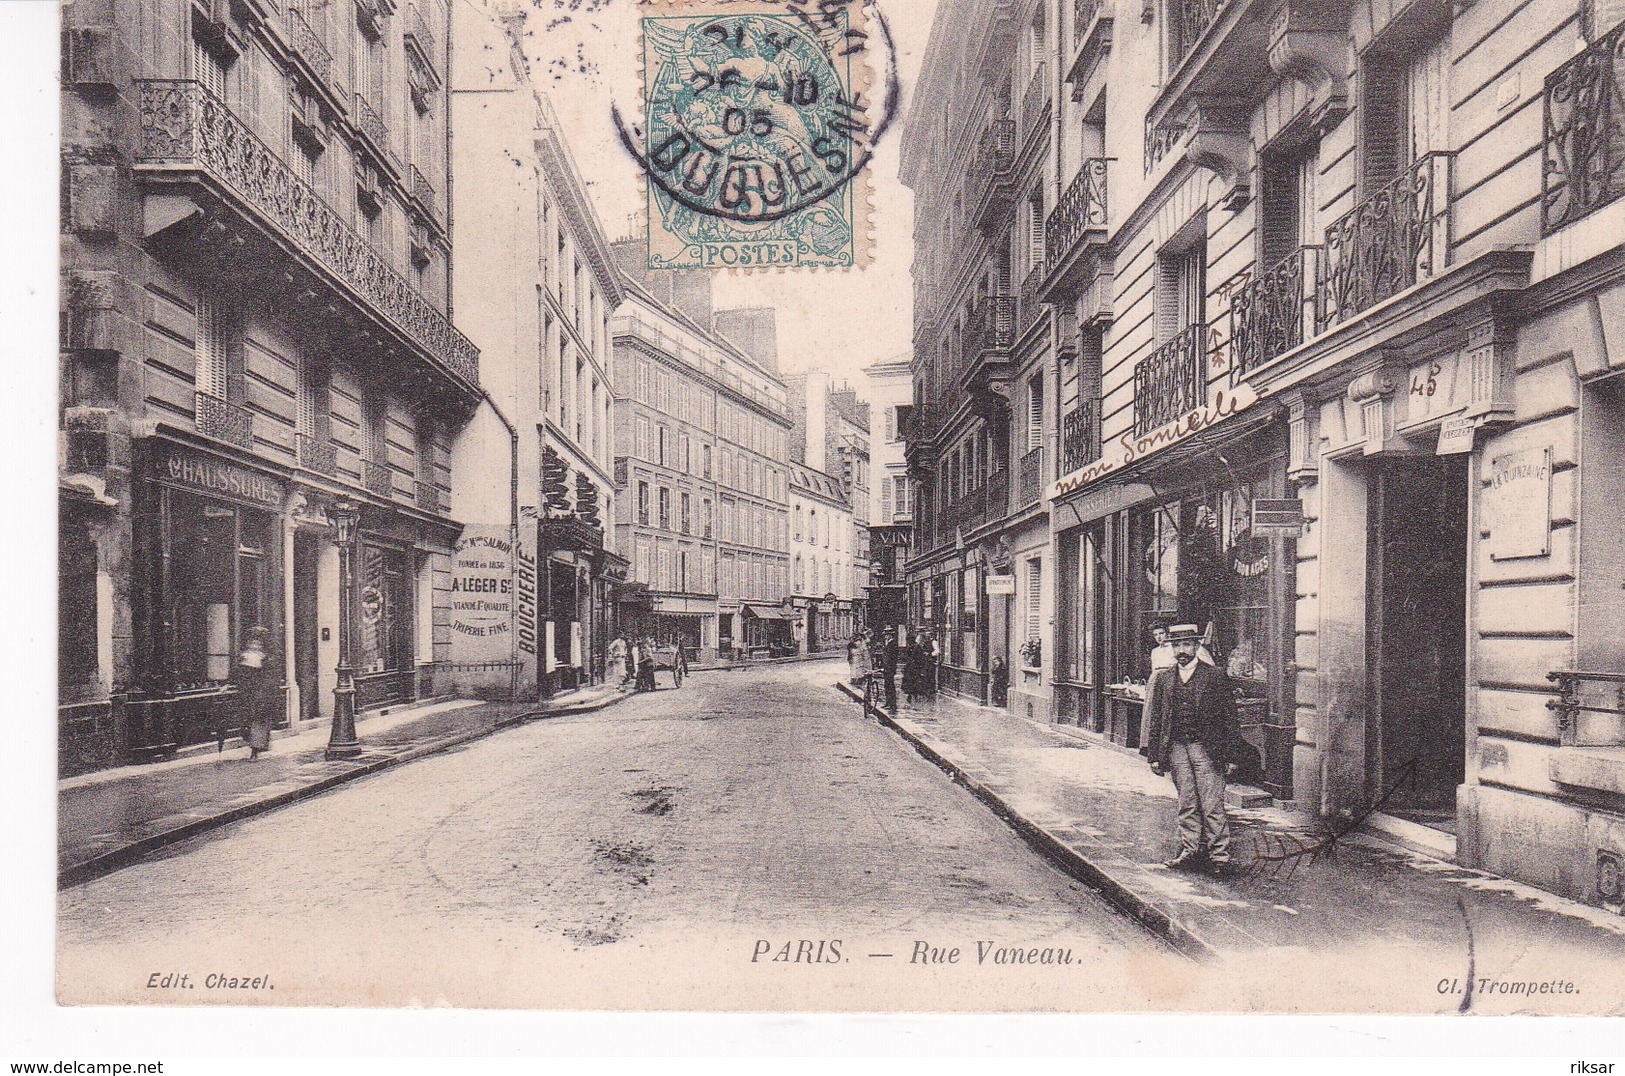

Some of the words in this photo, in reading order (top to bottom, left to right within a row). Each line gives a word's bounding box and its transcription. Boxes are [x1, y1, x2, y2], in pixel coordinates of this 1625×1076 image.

[723, 107, 773, 137] 05
[650, 90, 868, 208] DUQUESNE
[704, 241, 794, 266] POSTES
[1410, 363, 1442, 397] 45
[168, 455, 281, 504] CHAUSSURES
[1055, 462, 1113, 496] mon
[518, 549, 536, 655] BOUCHERIE
[452, 620, 486, 637] TRIPERIE
[488, 621, 510, 636] FINE
